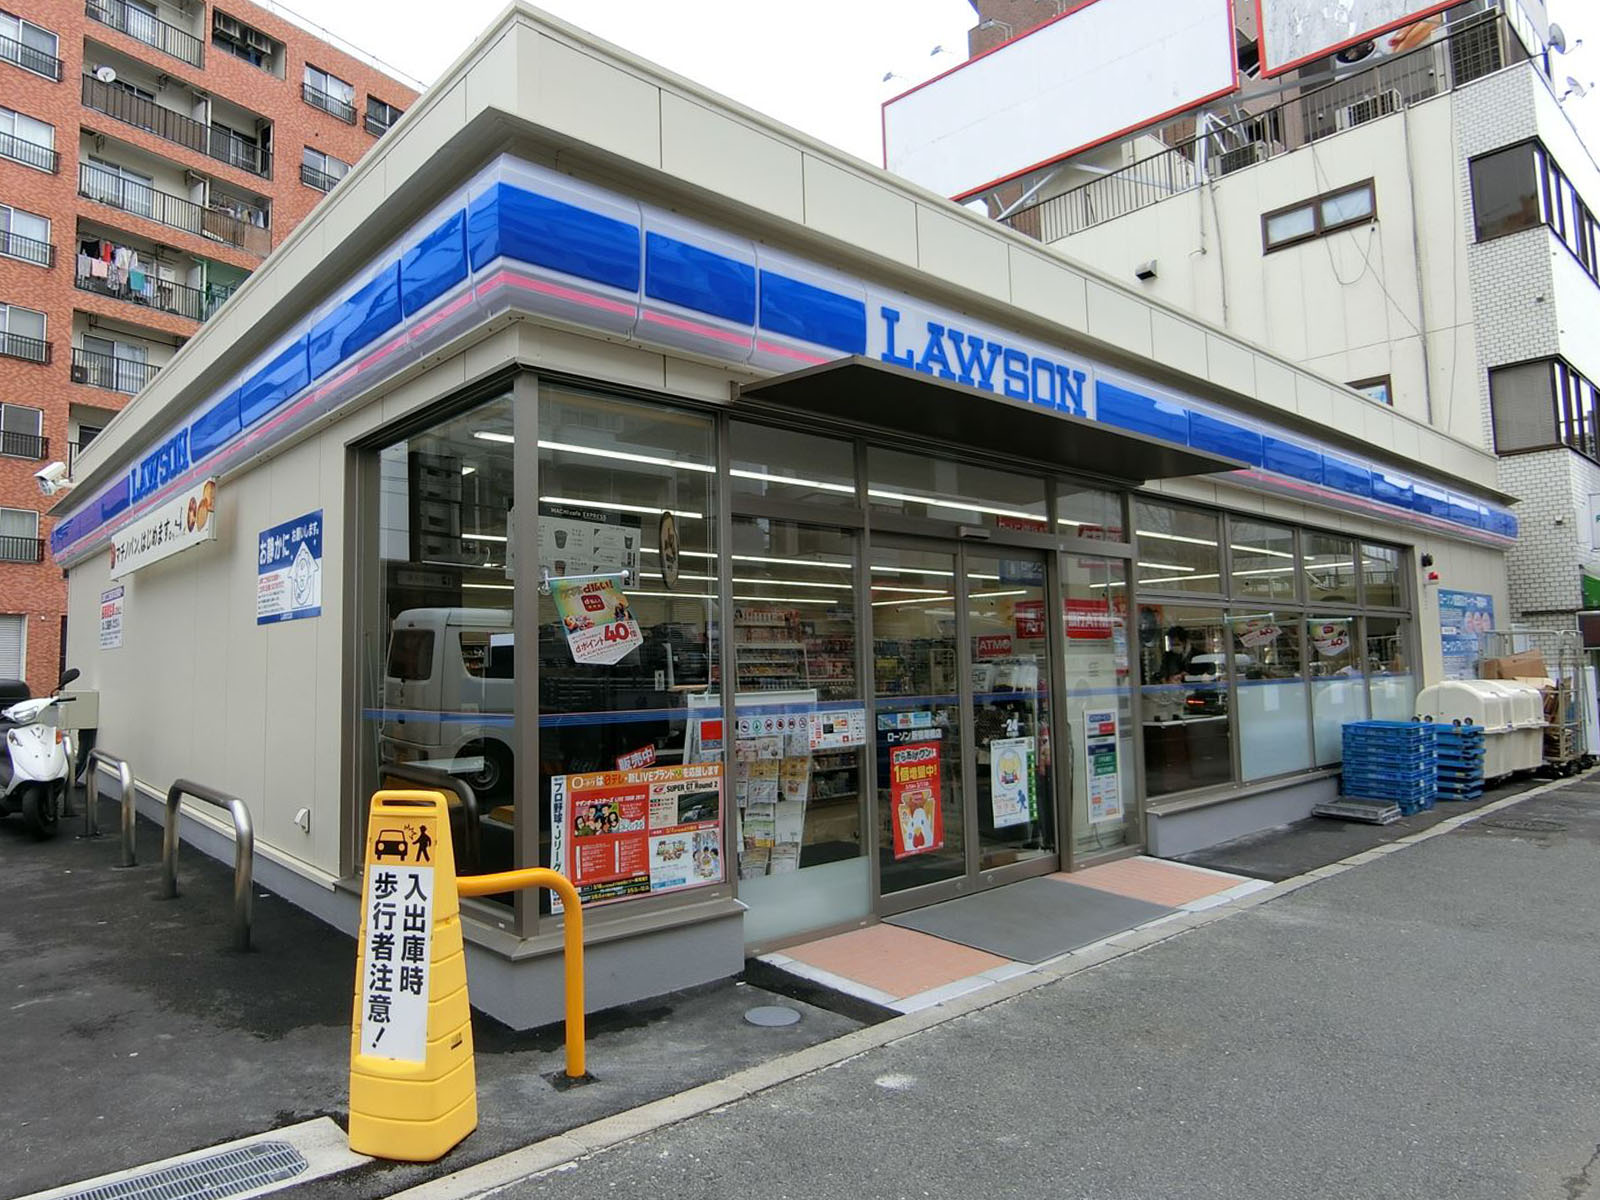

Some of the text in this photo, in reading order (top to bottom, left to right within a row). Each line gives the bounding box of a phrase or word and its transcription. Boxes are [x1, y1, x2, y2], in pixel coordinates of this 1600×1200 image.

[881, 306, 1087, 418] LAWSON
[131, 427, 189, 505] LAWSON
[605, 623, 630, 643] 40
[666, 785, 685, 793] SUPER
[368, 872, 398, 1048] 歩行者注意!
[400, 873, 427, 995] 入出庫時
